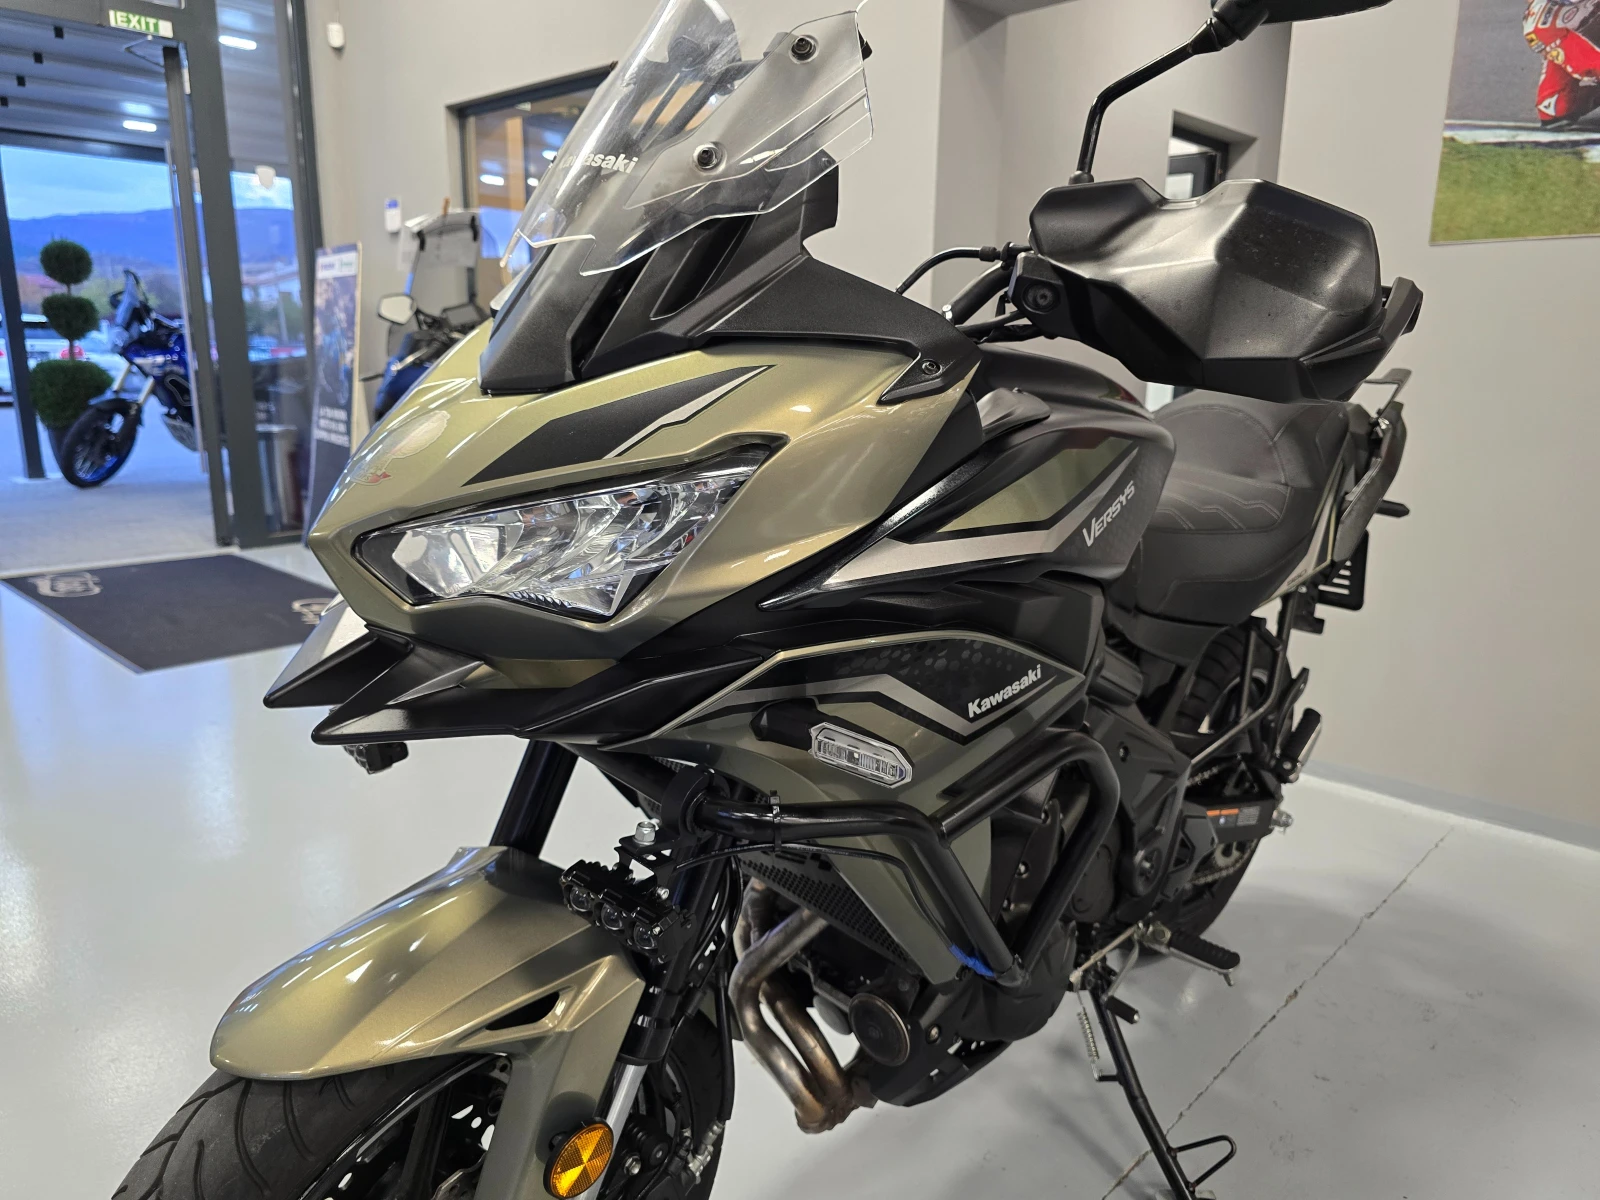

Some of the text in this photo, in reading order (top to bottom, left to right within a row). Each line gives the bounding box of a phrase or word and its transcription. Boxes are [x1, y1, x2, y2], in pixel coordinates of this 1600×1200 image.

[116, 11, 157, 33] EXIT
[1082, 480, 1135, 547] VERSYS
[967, 663, 1042, 718] Kawasaki
